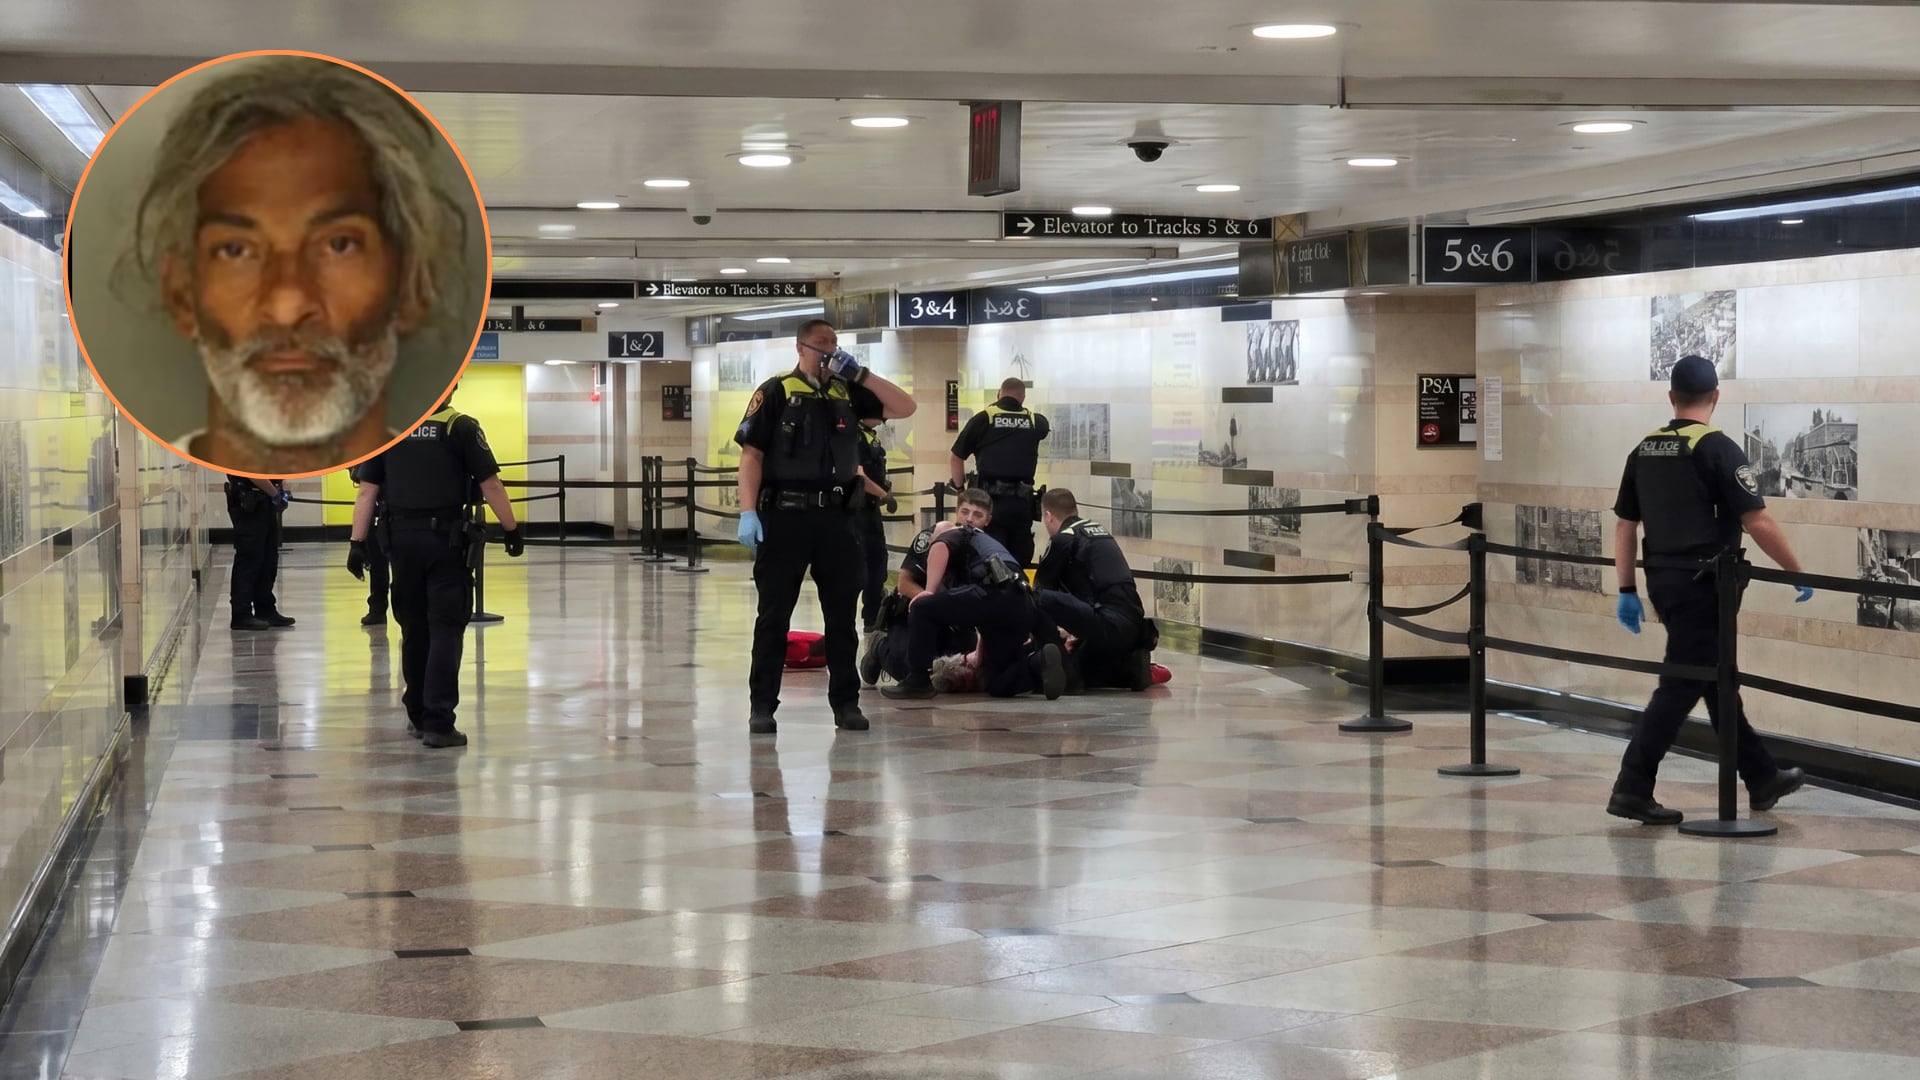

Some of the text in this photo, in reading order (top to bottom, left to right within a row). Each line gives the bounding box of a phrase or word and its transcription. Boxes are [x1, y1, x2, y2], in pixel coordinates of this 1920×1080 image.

[1044, 218, 1114, 235] Elevator
[1121, 221, 1138, 235] to
[1144, 218, 1202, 236] Tracks
[1225, 219, 1241, 235] &
[1248, 218, 1259, 235] 6
[1442, 238, 1514, 272] 5&6
[663, 283, 711, 296] Elevator
[715, 285, 727, 296] to
[730, 283, 769, 296] Tracks
[784, 283, 796, 295] &
[799, 284, 808, 295] 4
[910, 297, 957, 319] 3&4
[620, 333, 655, 357] 1&2
[1421, 377, 1454, 394] PSA
[411, 426, 437, 438] LICE
